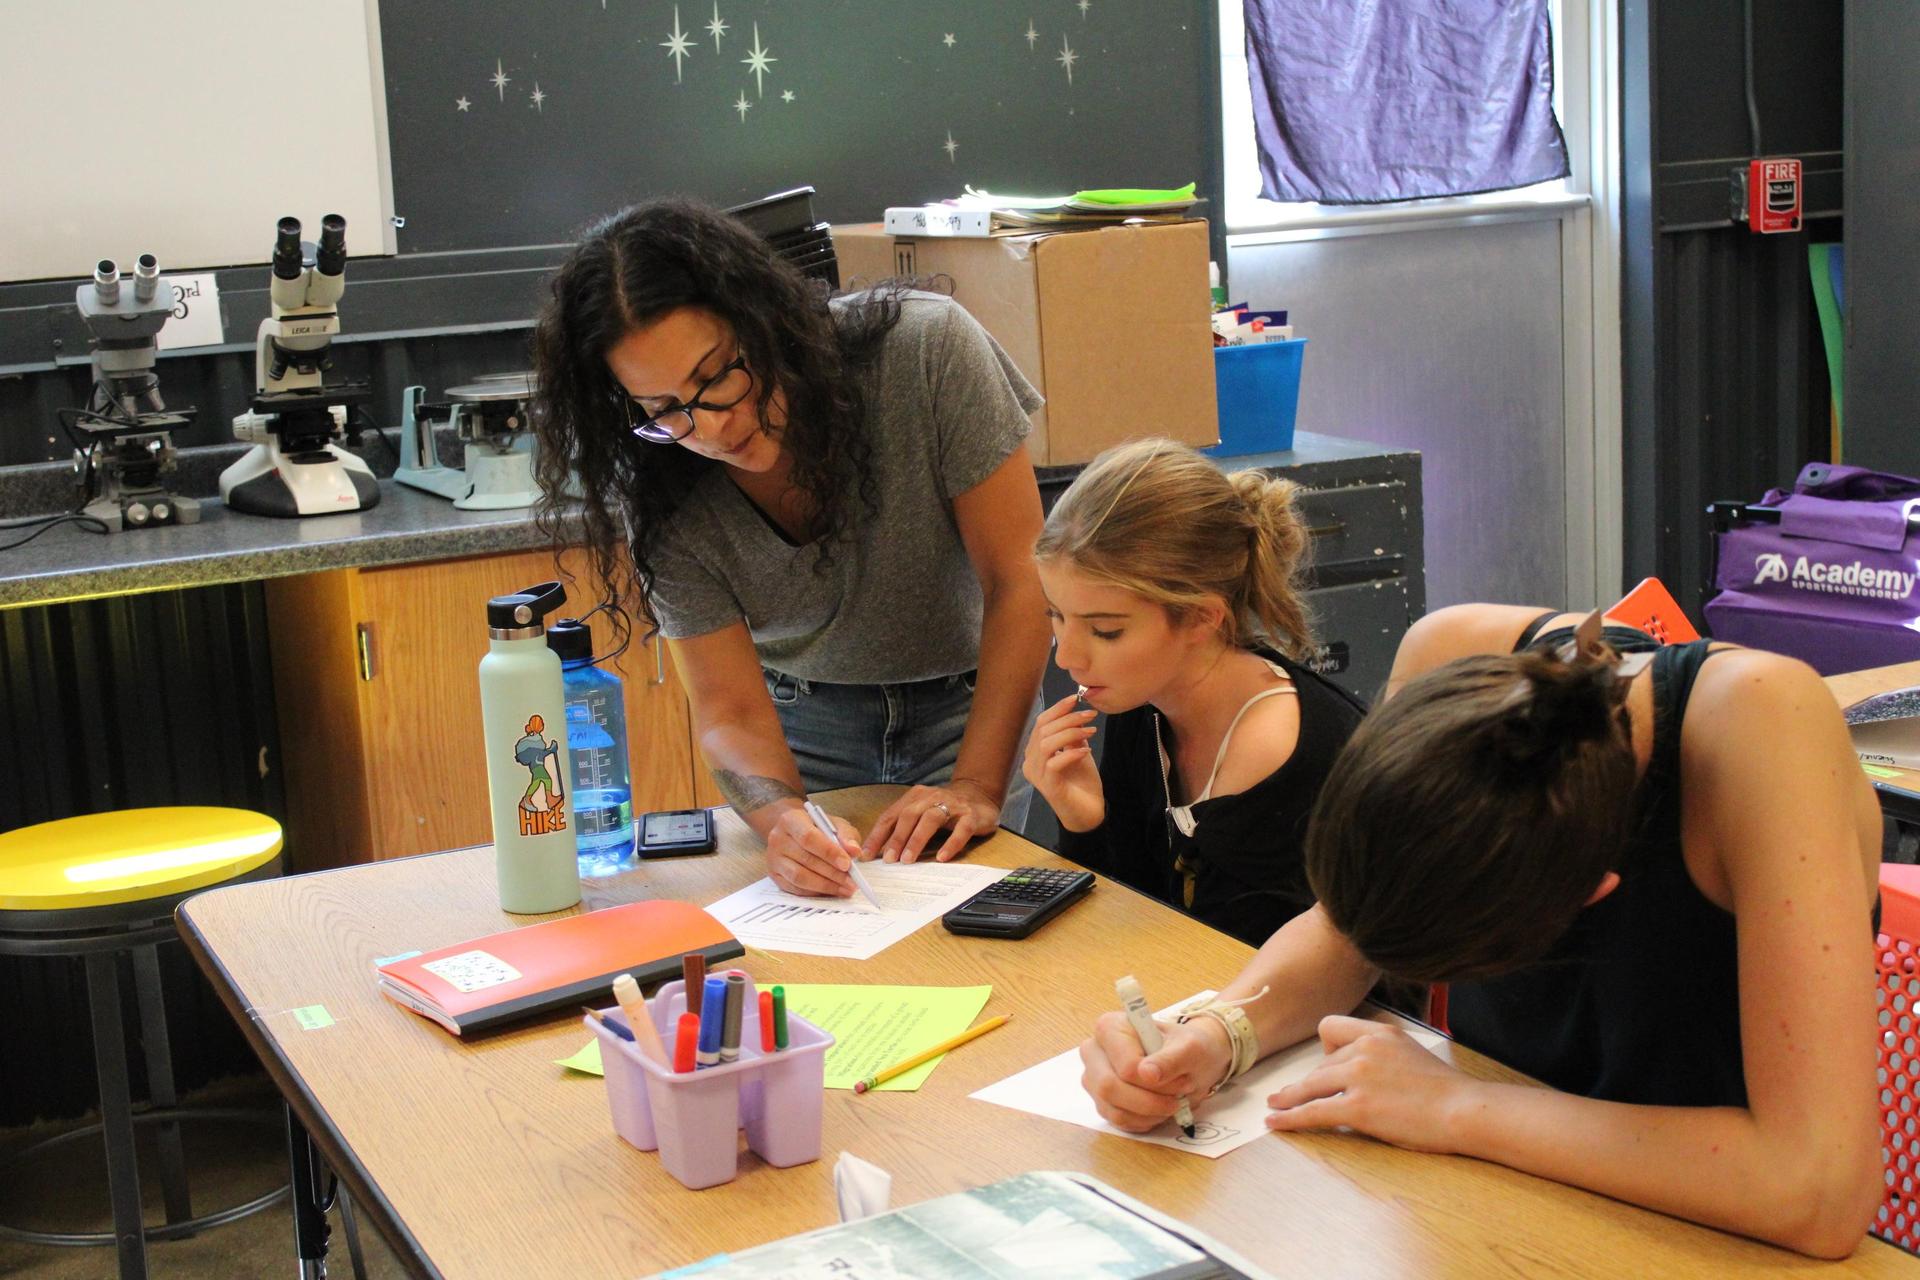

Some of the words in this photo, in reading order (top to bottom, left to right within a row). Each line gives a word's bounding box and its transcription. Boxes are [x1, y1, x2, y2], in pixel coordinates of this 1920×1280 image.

[1765, 163, 1797, 179] FIRE
[171, 280, 201, 320] 3rd
[1791, 556, 1916, 599] Academy
[518, 799, 567, 836] HIKE
